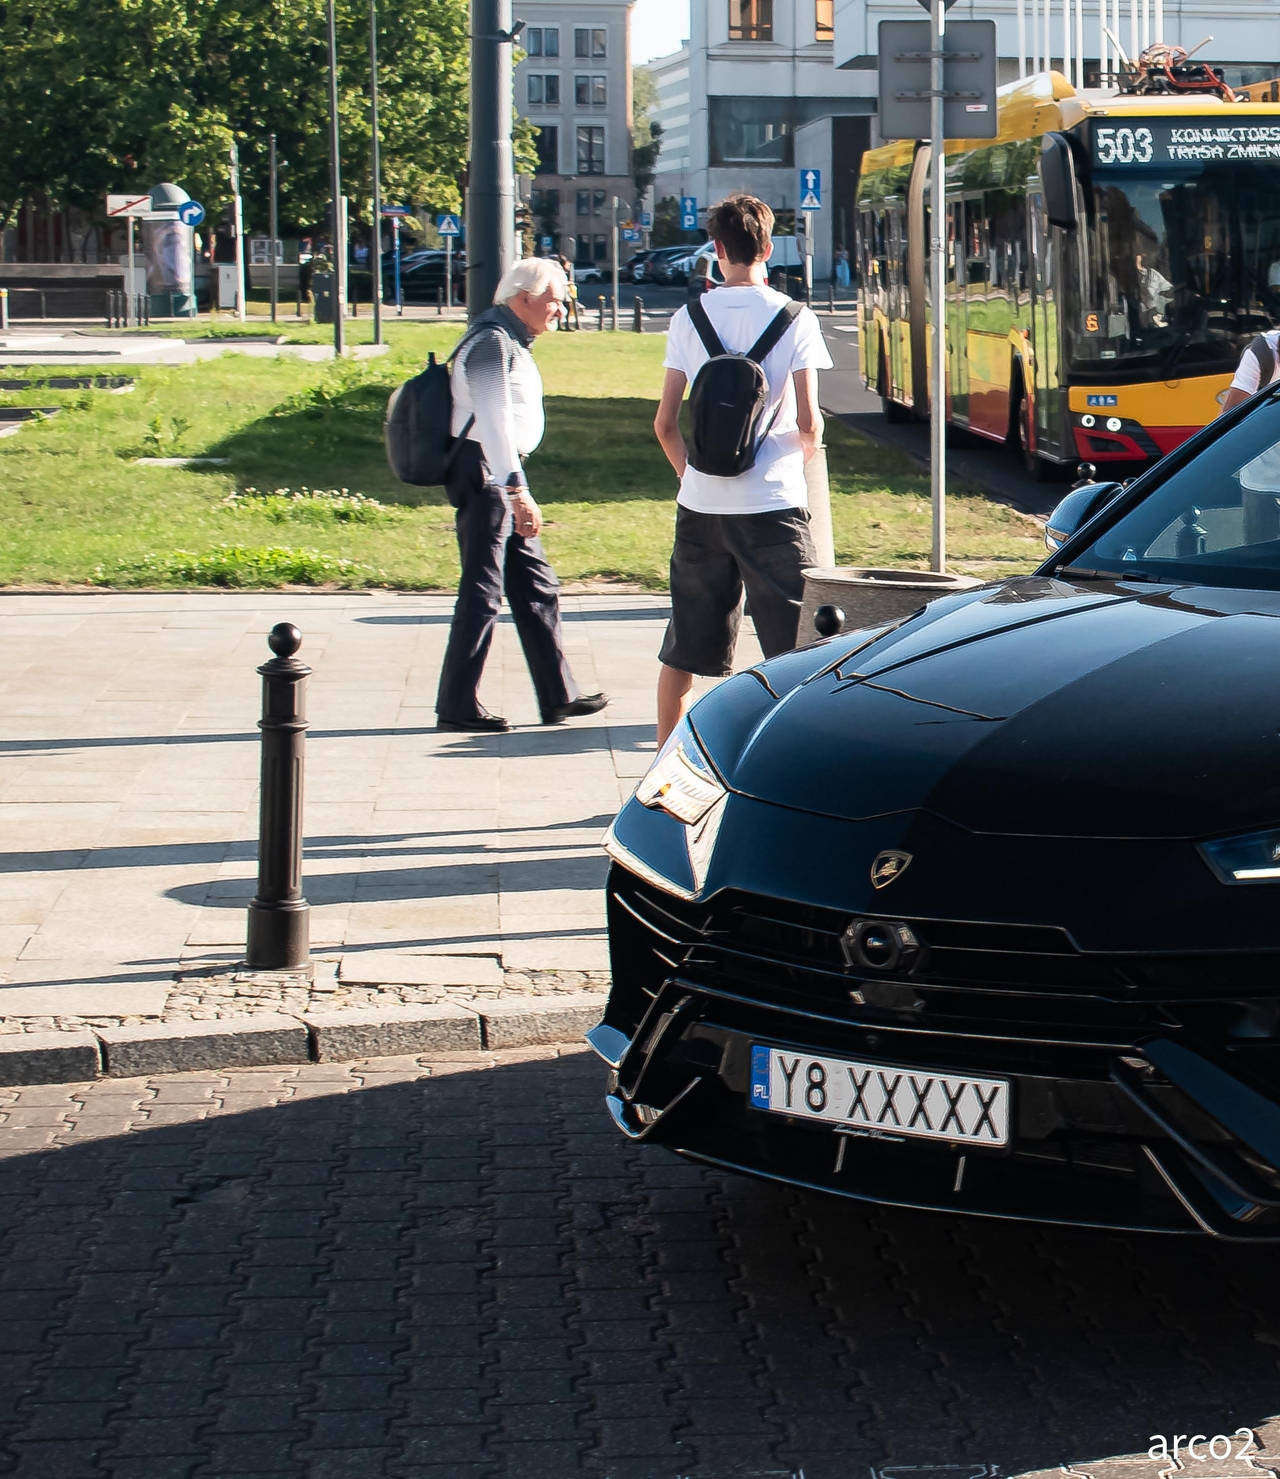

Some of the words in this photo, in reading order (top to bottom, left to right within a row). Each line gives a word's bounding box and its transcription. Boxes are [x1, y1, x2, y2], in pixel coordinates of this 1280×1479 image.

[1097, 128, 1154, 164] 503
[1166, 144, 1225, 159] TRASA
[683, 215, 695, 228] P
[753, 1084, 770, 1099] PL
[777, 1055, 829, 1113] Y8
[846, 1066, 1001, 1139] XXXXX
